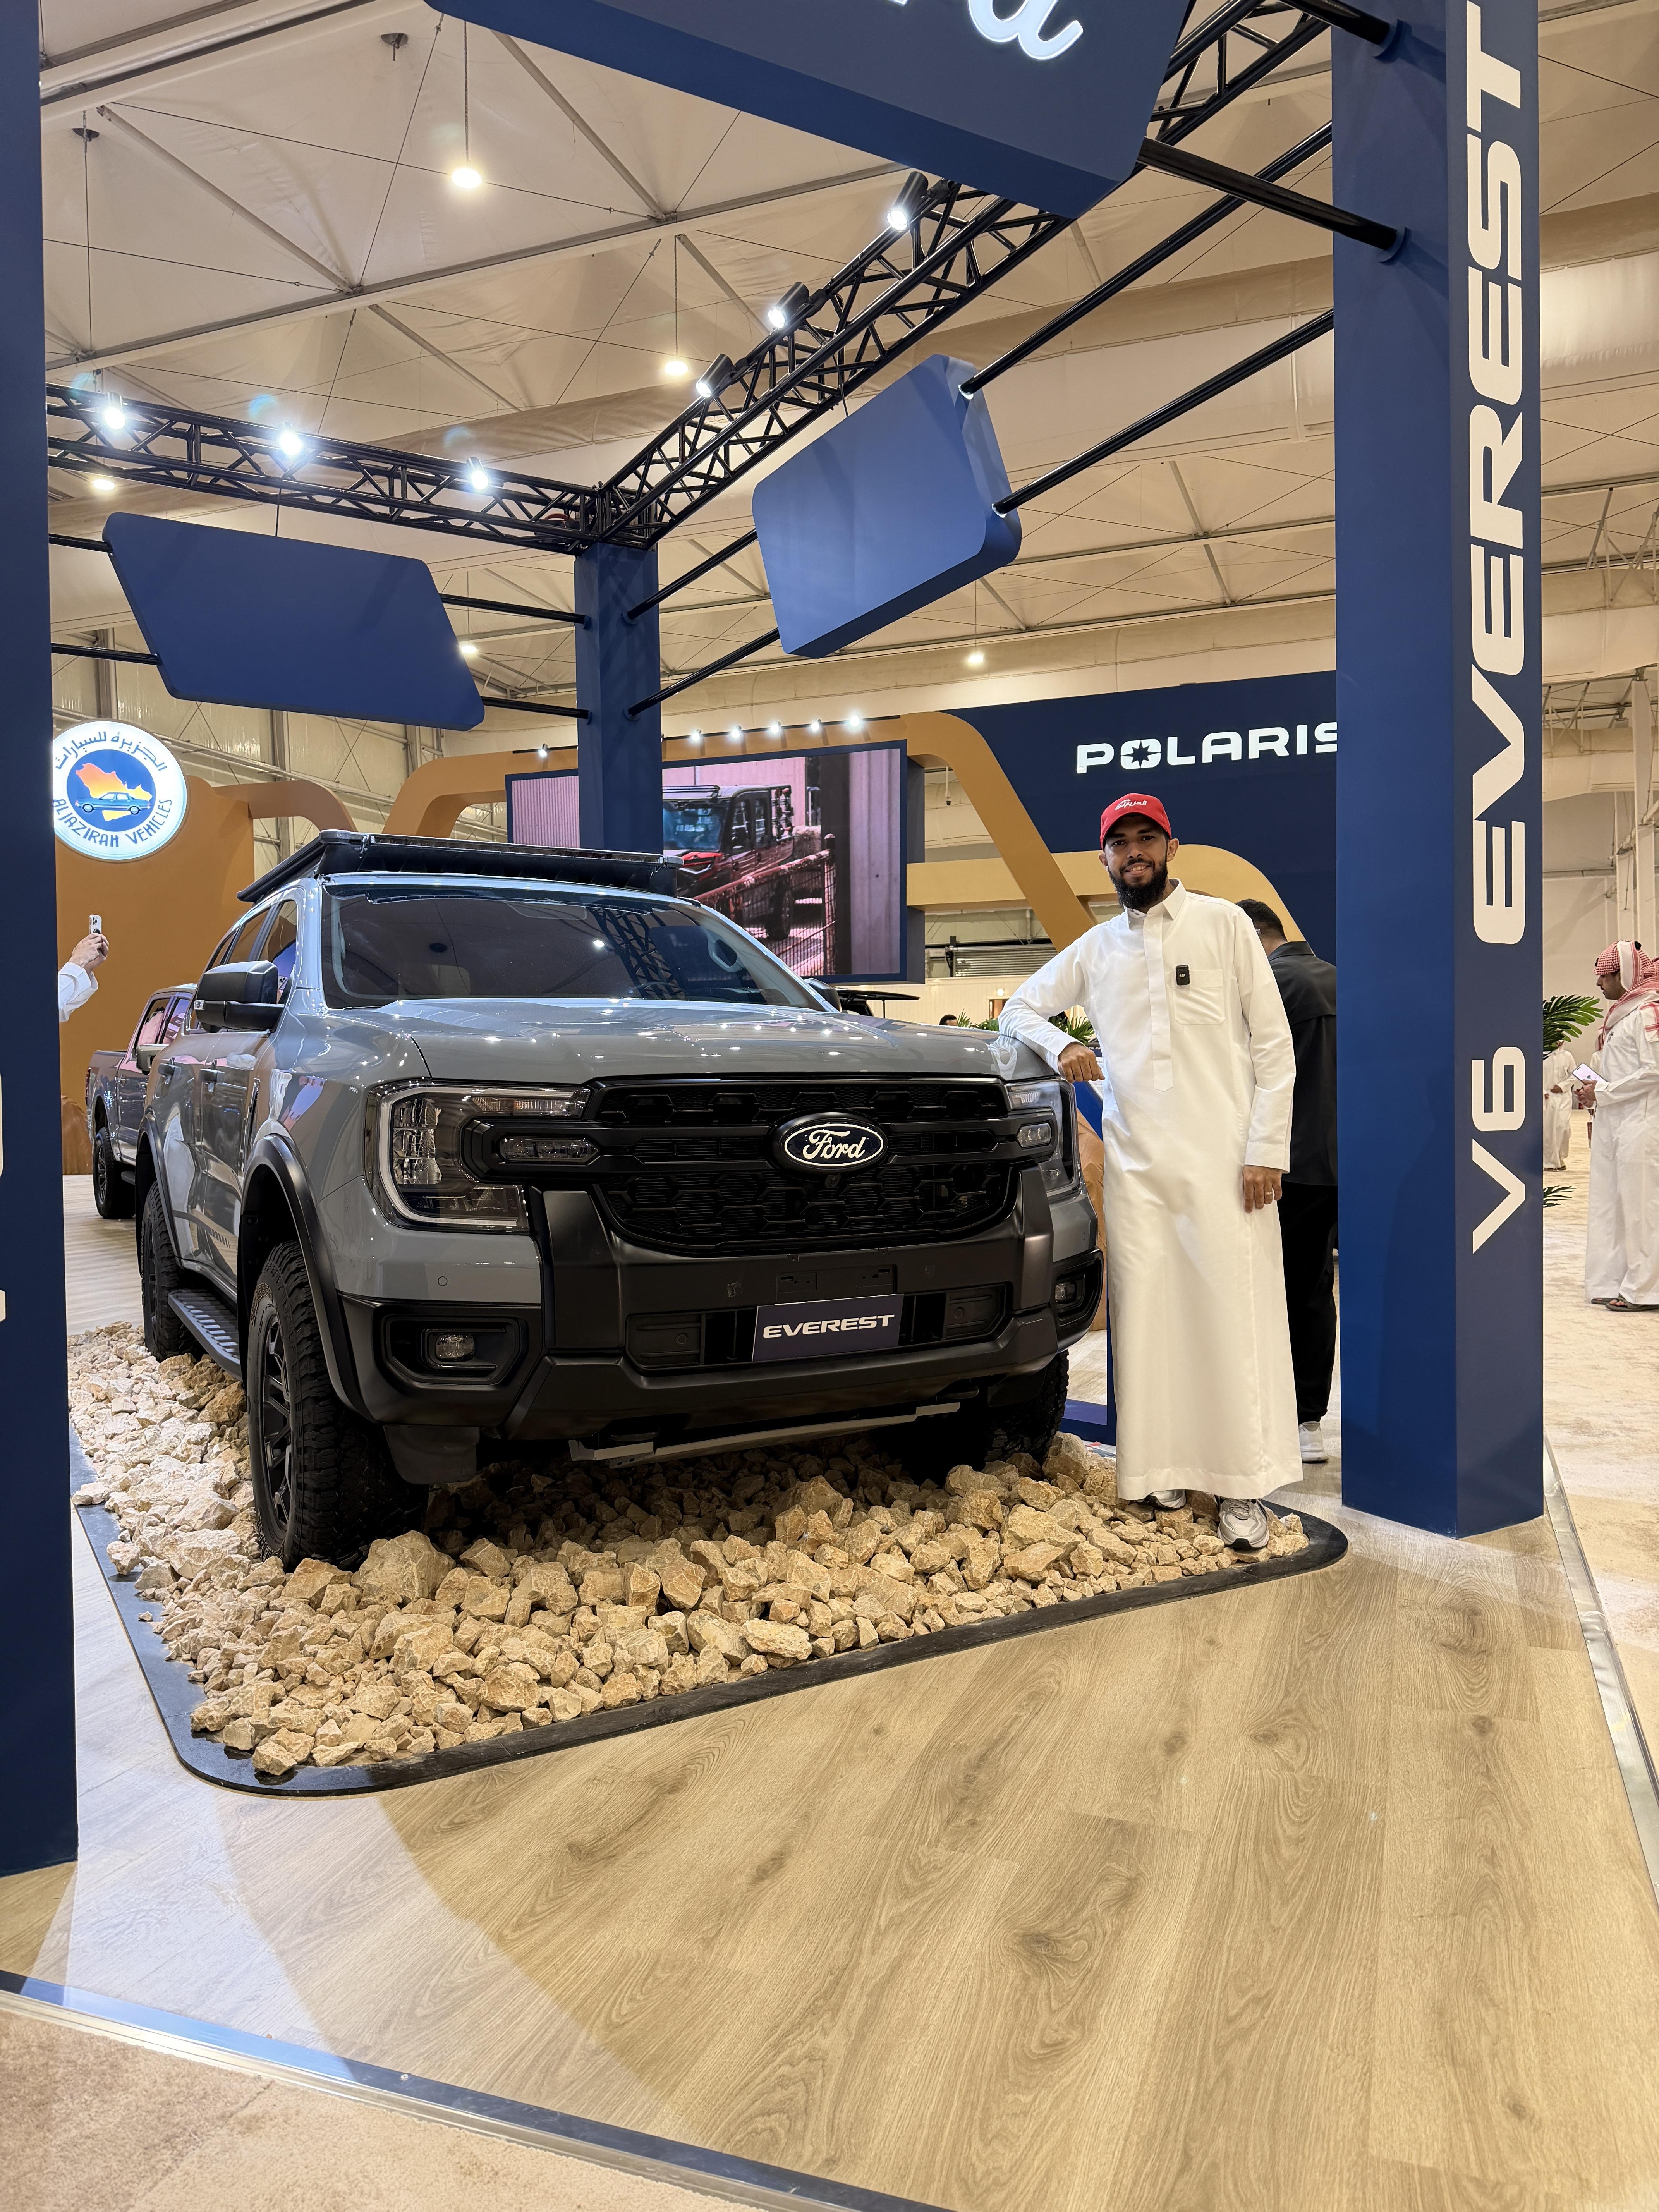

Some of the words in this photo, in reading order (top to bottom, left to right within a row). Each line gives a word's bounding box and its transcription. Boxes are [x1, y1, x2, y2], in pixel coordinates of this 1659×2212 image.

[1467, 0, 1525, 945] EVEREST
[55, 731, 106, 769] للسيارات
[111, 731, 167, 771] الجزيرة
[1077, 722, 1337, 774] POLARIS
[125, 799, 172, 844] VEHICLES
[803, 1128, 866, 1159] Ford
[1472, 1046, 1525, 1254] V6
[763, 1314, 895, 1338] EVEREST
